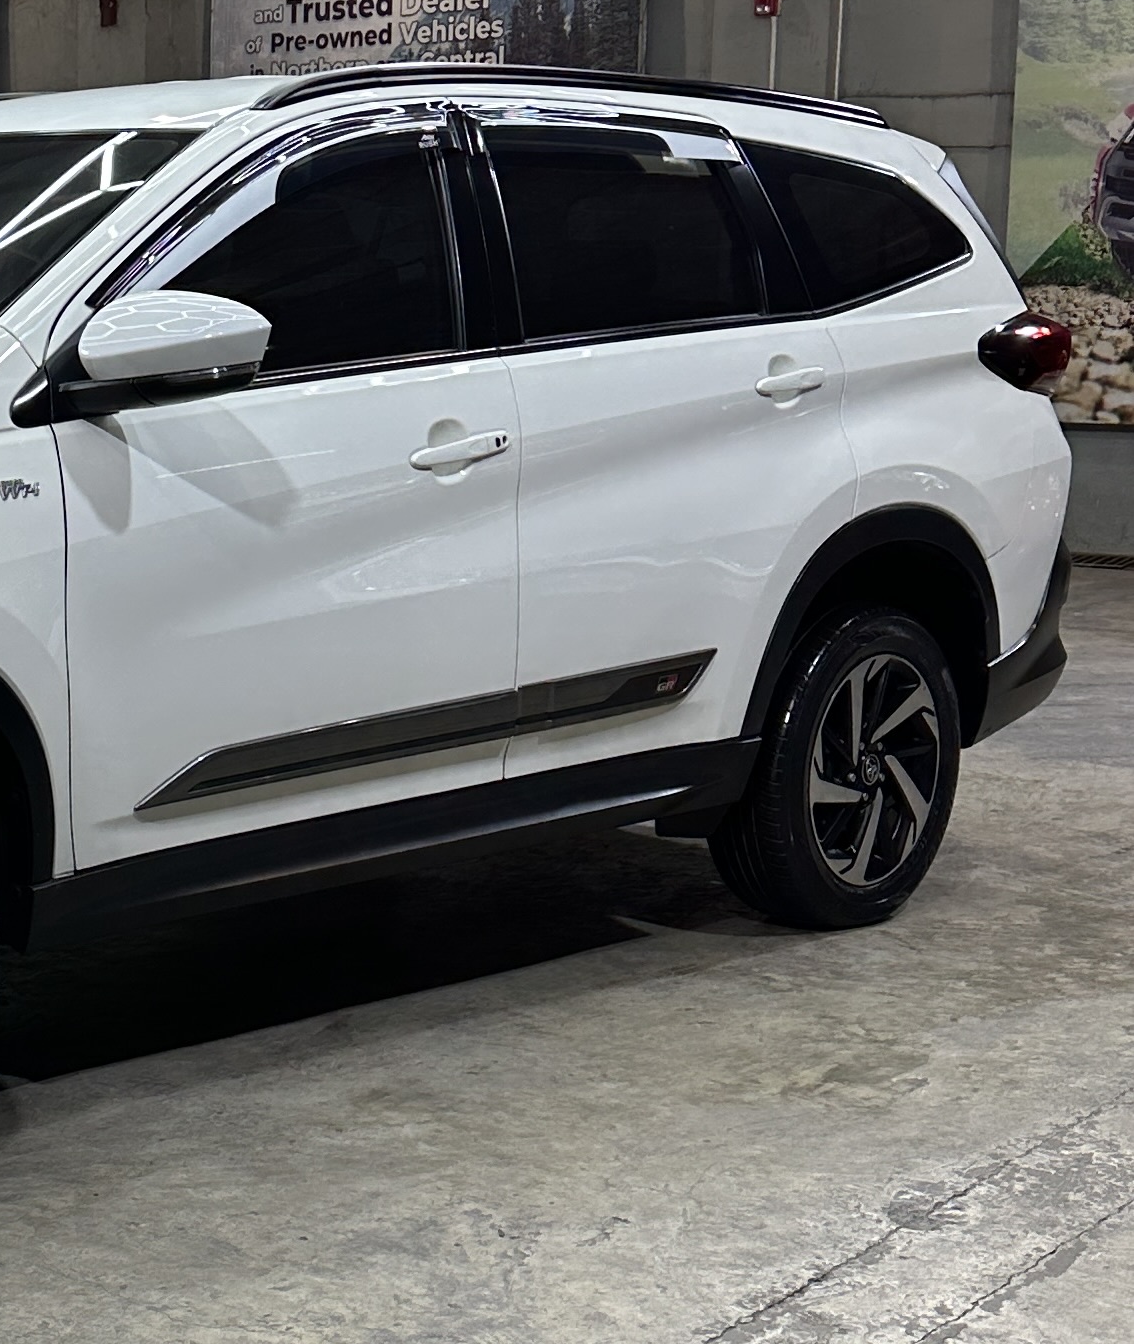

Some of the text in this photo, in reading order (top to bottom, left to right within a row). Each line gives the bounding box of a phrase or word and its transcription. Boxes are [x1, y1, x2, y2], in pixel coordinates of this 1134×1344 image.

[254, 5, 284, 24] and
[245, 15, 505, 54] of Pre-owned Vehicles
[271, 56, 369, 76] North
